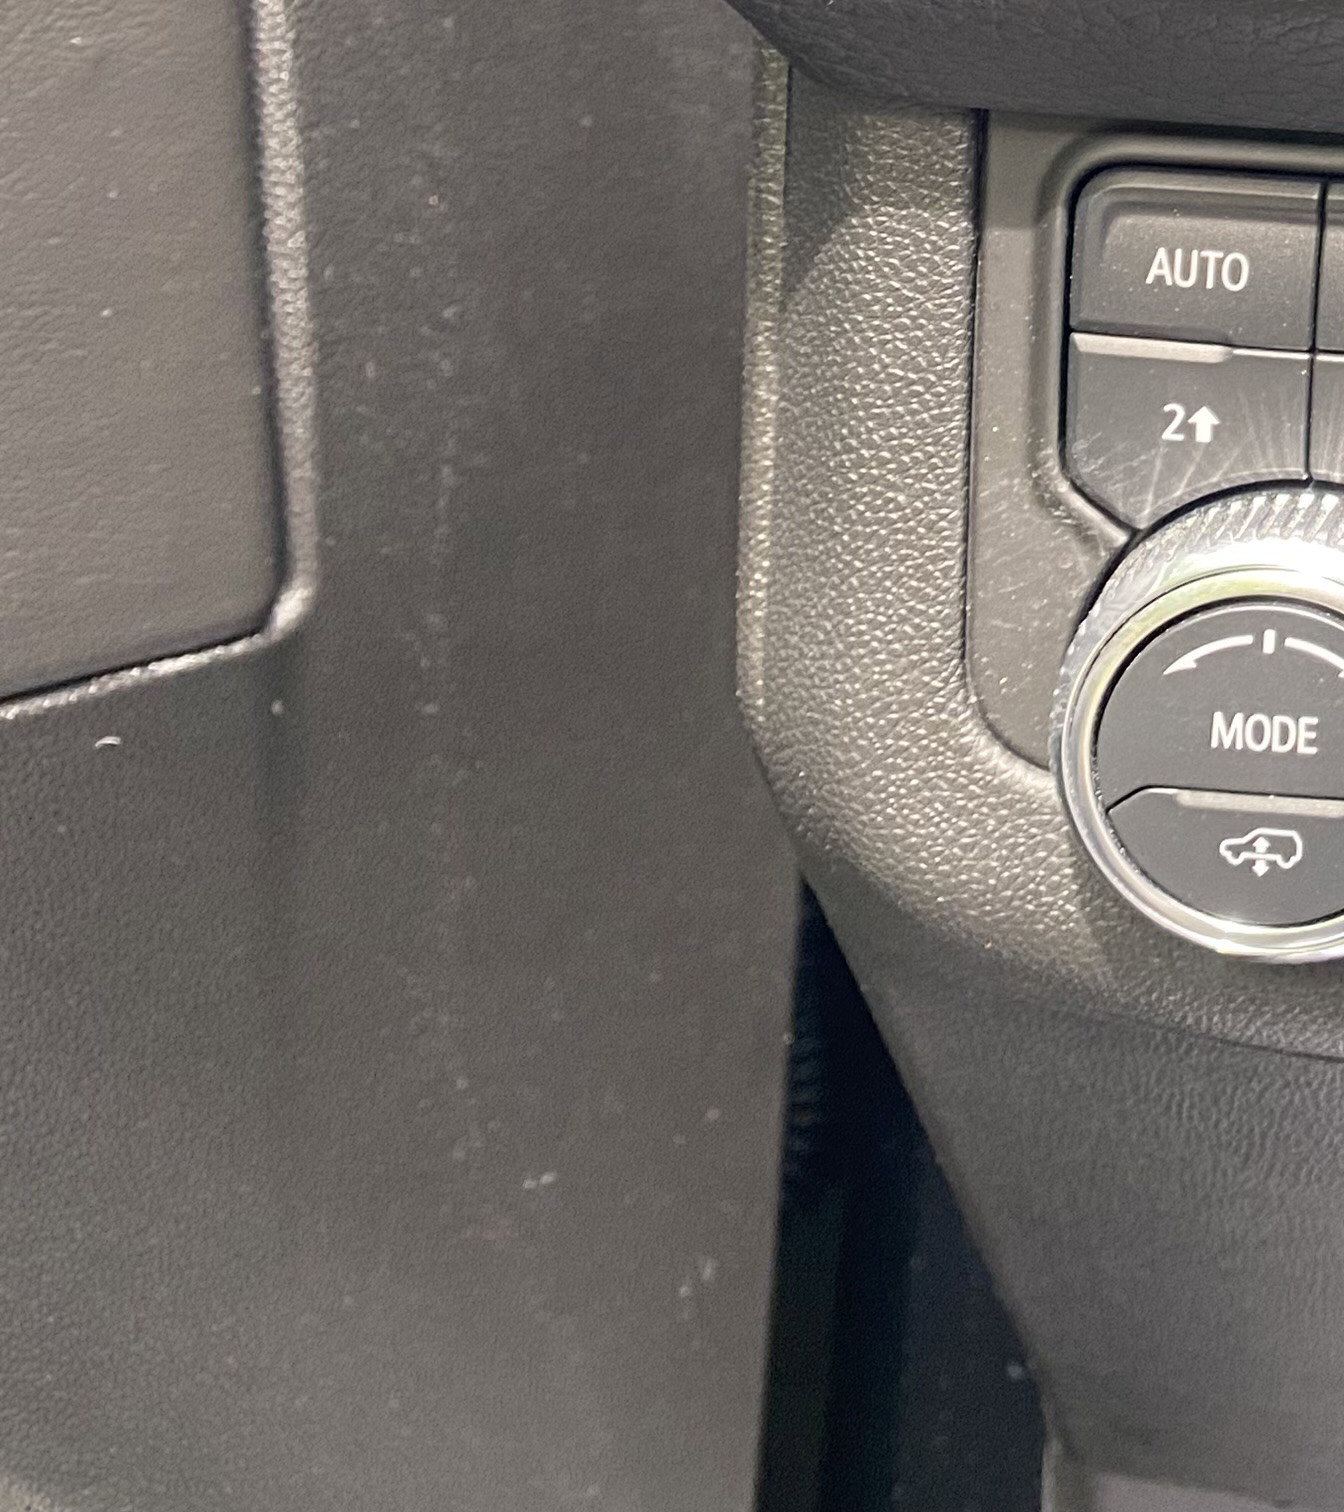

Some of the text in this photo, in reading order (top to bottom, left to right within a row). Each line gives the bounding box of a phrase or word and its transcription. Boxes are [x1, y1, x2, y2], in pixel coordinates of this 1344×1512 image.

[1145, 247, 1250, 292] AUTO
[1160, 403, 1188, 443] 2
[1210, 710, 1319, 756] MODE
